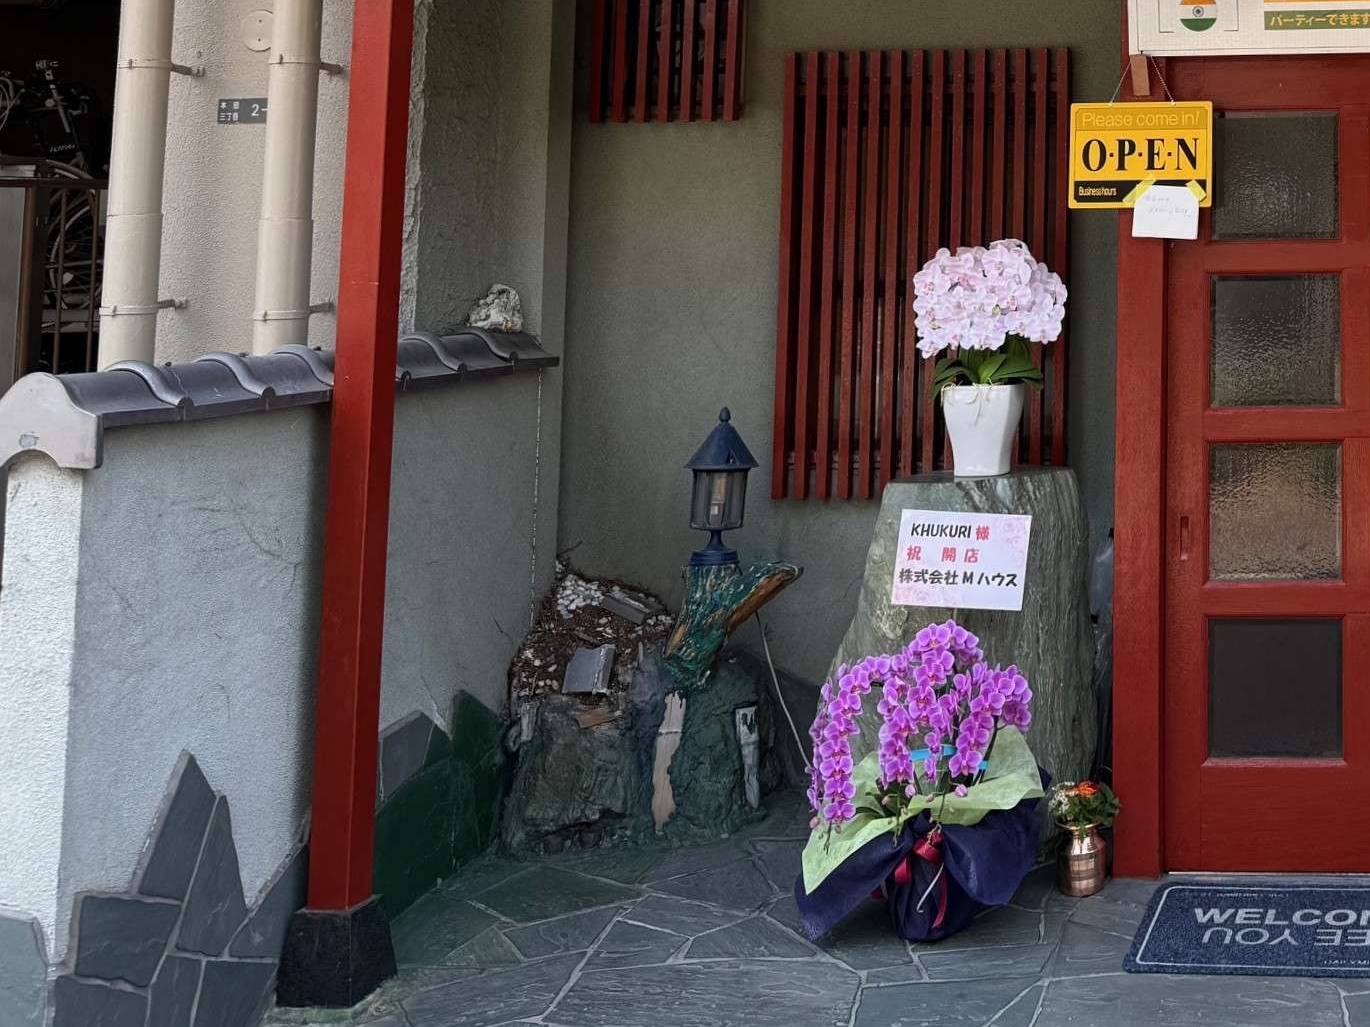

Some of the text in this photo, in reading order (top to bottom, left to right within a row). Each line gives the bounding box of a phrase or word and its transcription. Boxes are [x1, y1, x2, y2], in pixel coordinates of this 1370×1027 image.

[1082, 111, 1200, 127] Please come in!
[911, 523, 990, 541] KHUKURI 様
[906, 545, 922, 561] 祝
[1202, 927, 1299, 947] YOU
